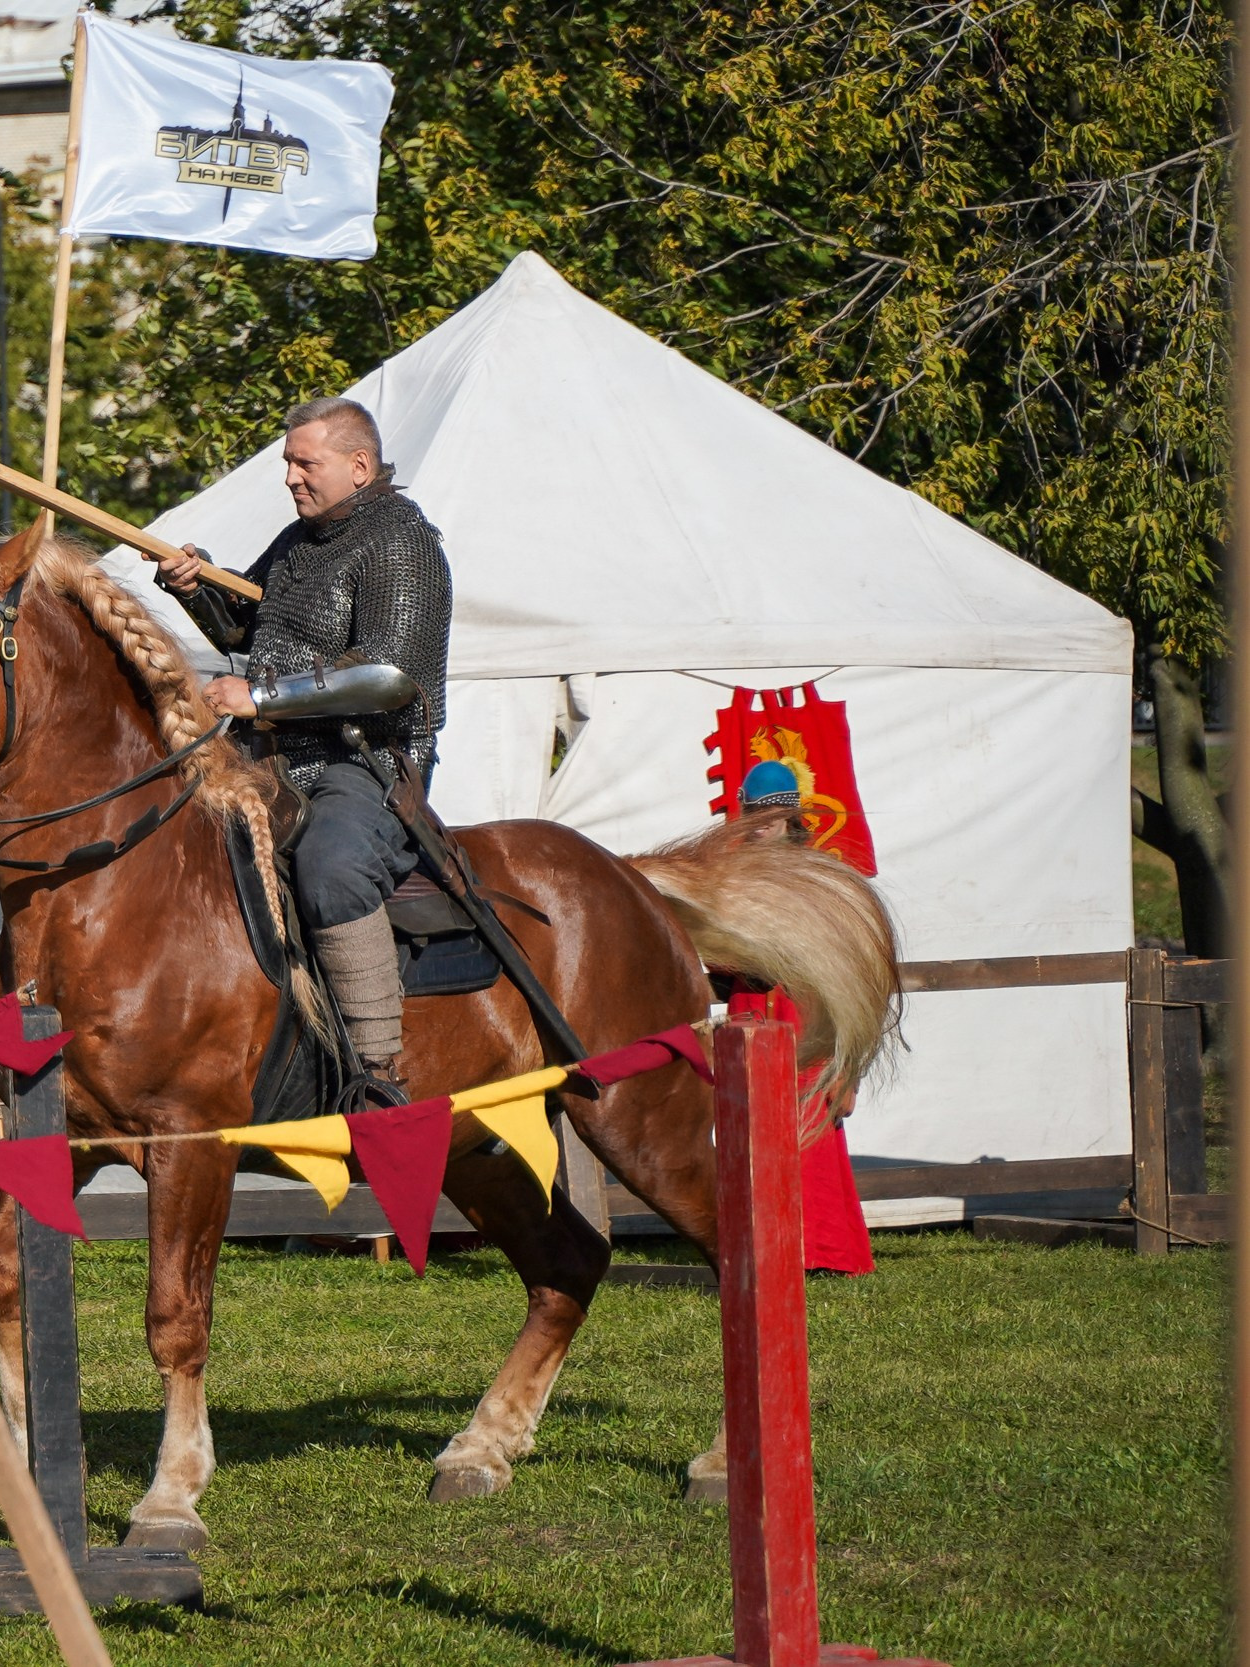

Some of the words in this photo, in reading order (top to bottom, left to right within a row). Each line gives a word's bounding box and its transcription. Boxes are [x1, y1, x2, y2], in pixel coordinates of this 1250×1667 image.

[155, 129, 310, 175] БИТВА
[188, 167, 216, 180] НА
[220, 170, 275, 187] НЕВЕ
